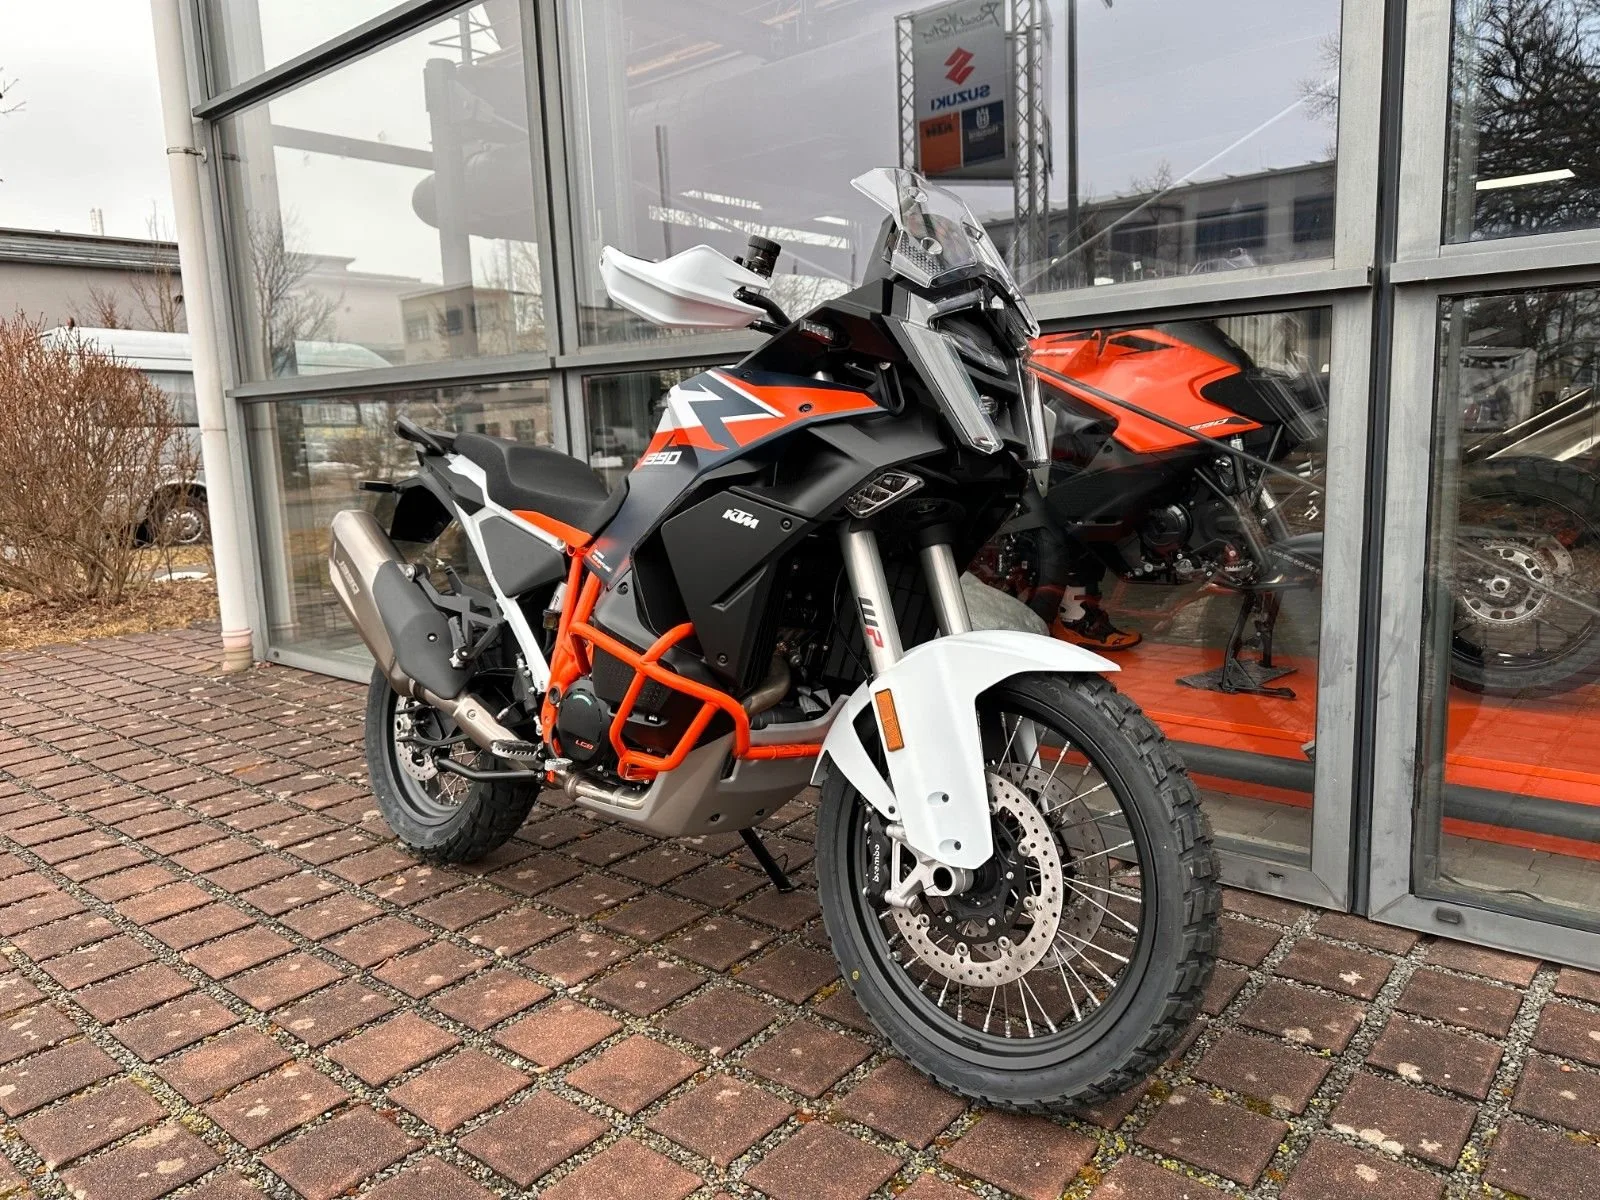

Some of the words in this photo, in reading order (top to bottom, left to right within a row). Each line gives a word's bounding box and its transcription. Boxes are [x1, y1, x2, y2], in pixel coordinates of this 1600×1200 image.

[722, 508, 760, 530] KTM
[858, 596, 884, 649] WP
[872, 843, 880, 883] brembo
